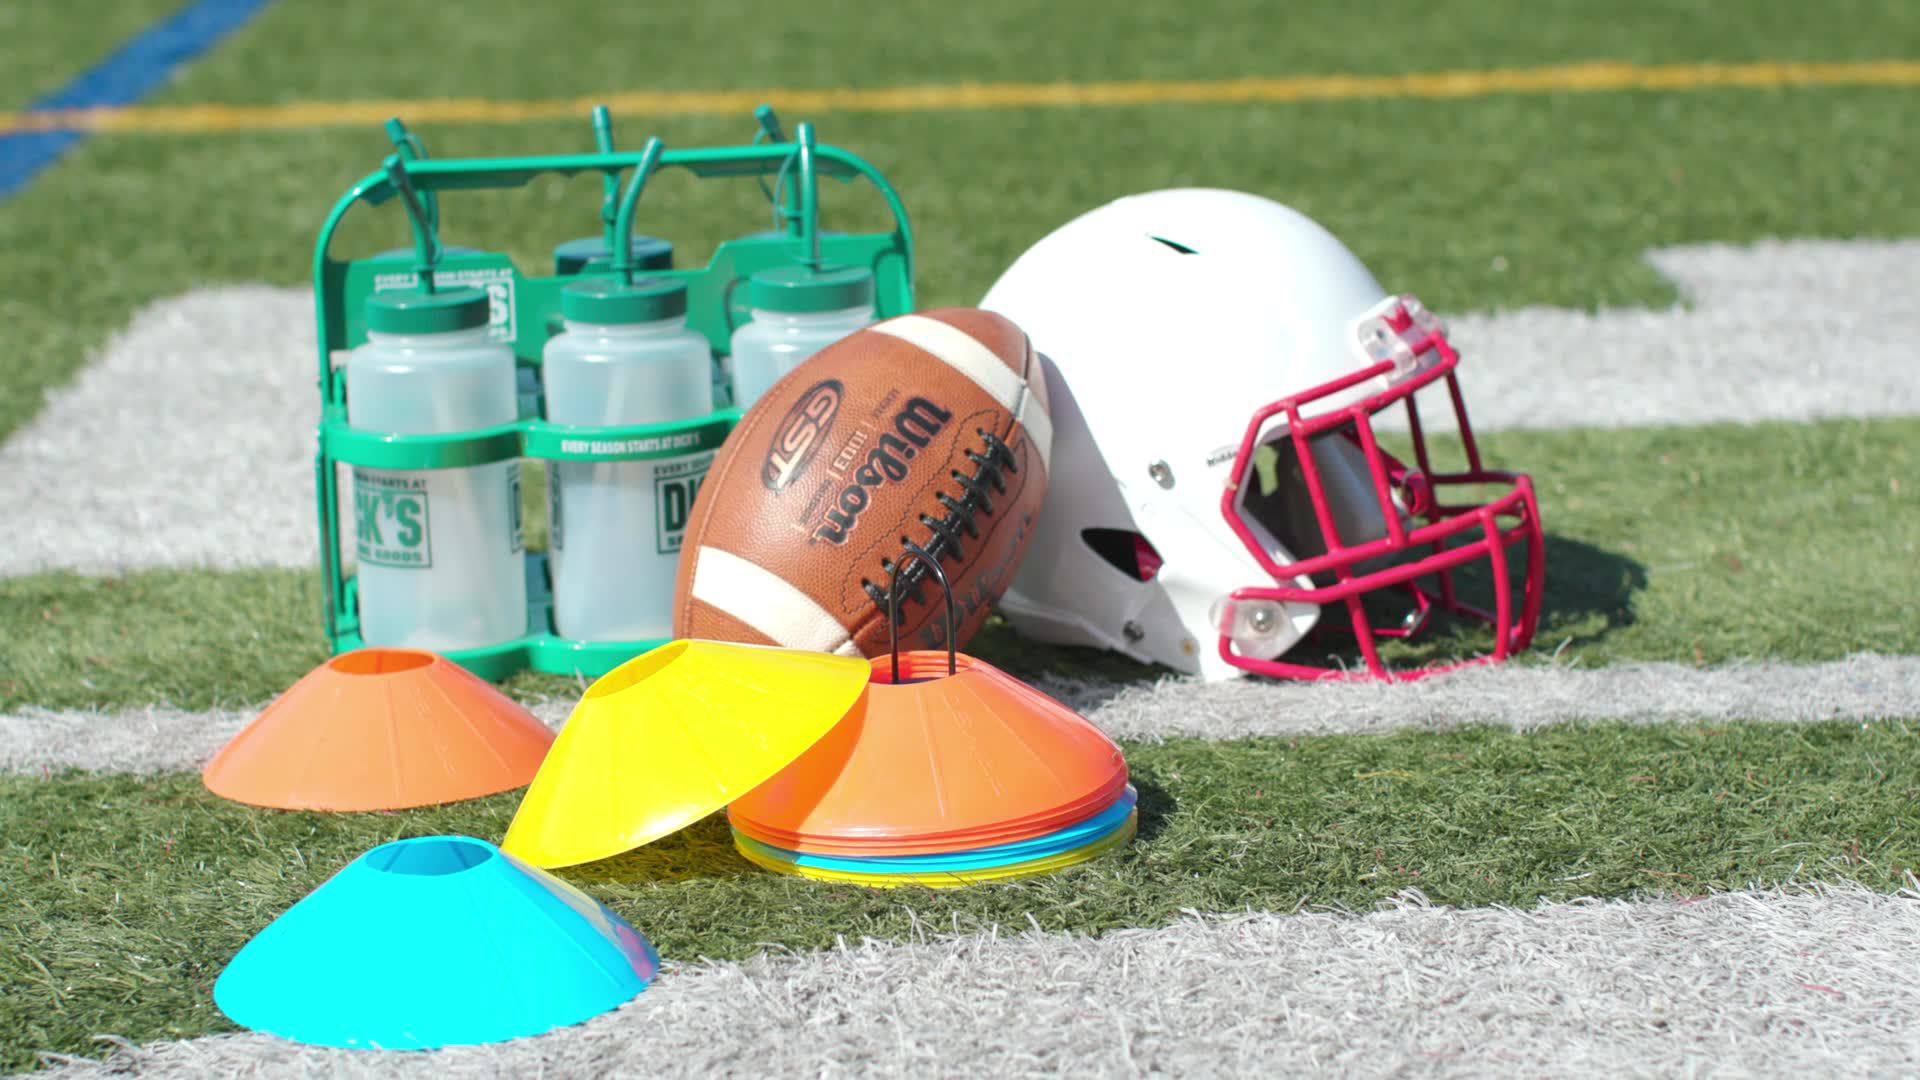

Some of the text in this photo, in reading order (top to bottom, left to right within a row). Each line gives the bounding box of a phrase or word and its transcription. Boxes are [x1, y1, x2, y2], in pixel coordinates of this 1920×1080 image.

[561, 440, 588, 453] EVERY
[591, 440, 626, 454] SEASON
[628, 438, 660, 453] STARTS
[662, 436, 672, 449] AT
[769, 386, 839, 490] GST
[832, 430, 868, 472] 1003
[654, 463, 688, 474] EVERY
[811, 396, 953, 545] Wilson
[355, 489, 423, 547] CK'S
